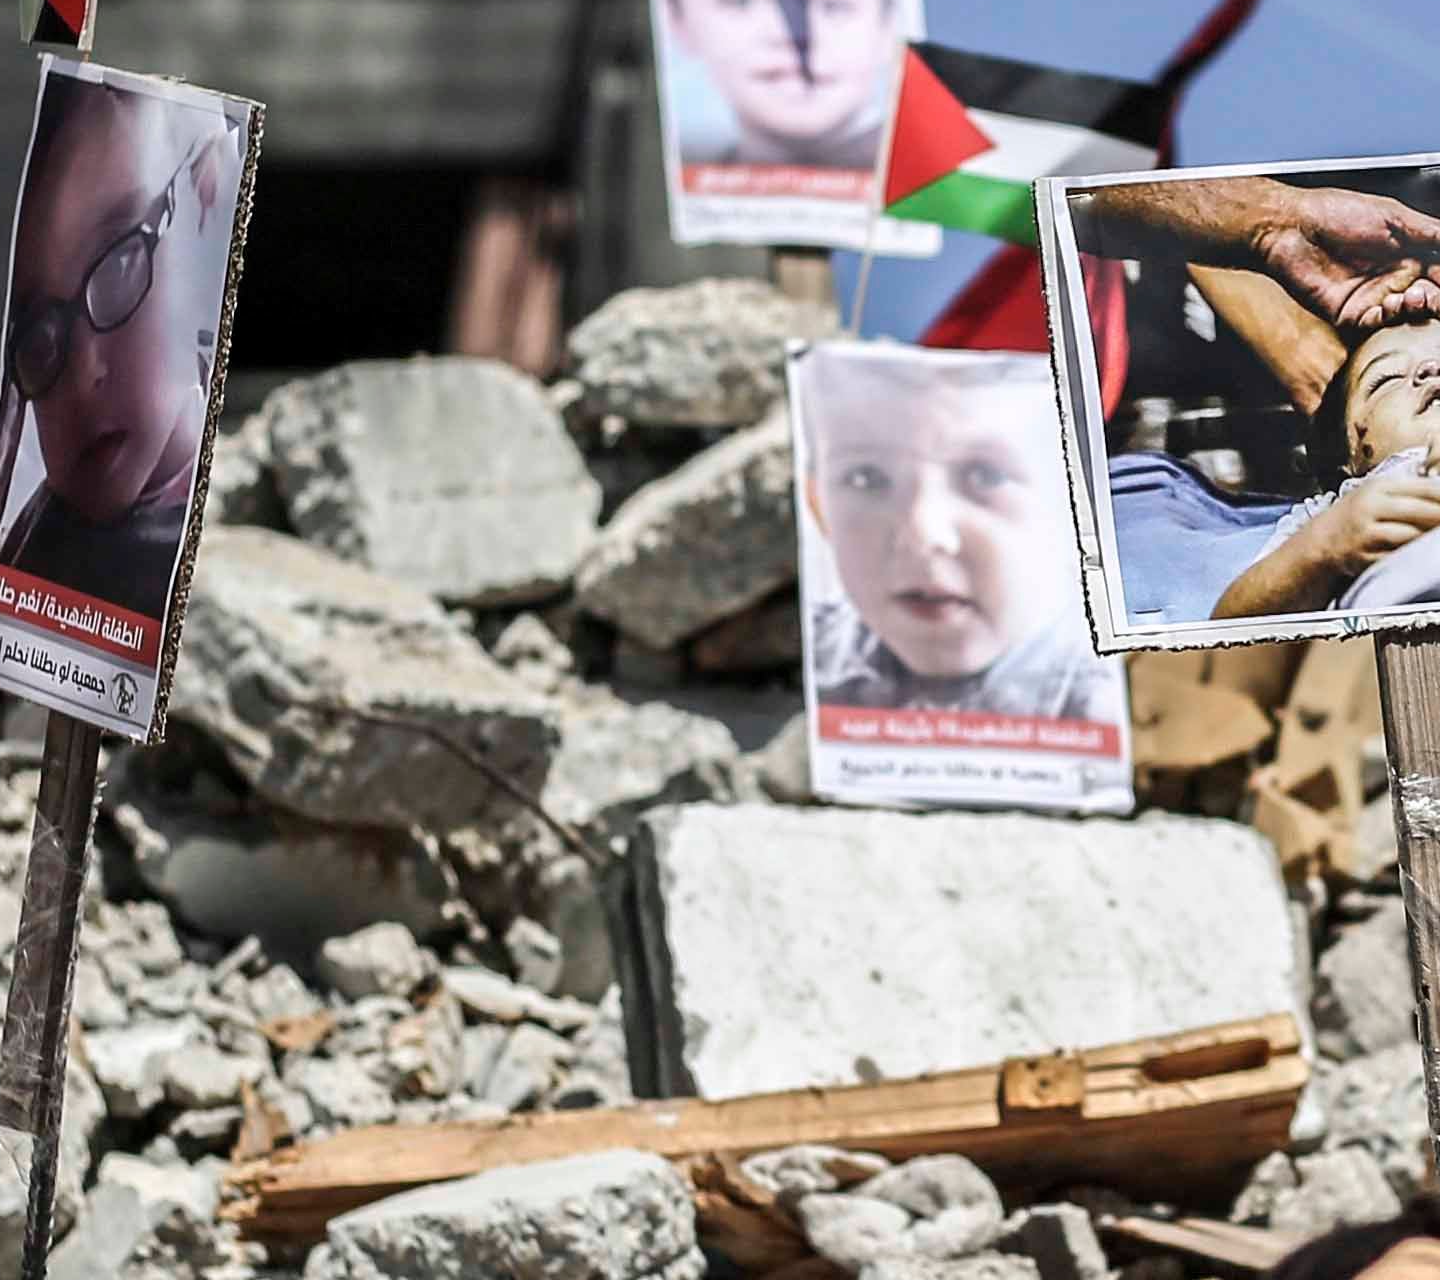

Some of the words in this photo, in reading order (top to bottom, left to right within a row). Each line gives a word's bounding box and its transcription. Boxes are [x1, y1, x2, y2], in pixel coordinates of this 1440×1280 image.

[15, 588, 41, 615] نغم
[40, 593, 102, 635] الشهيدة/
[102, 616, 143, 651] الطفلة
[2, 640, 30, 664] نحلم
[30, 647, 57, 680] بطلنا
[59, 660, 71, 684] لو
[72, 664, 105, 699] جمعية
